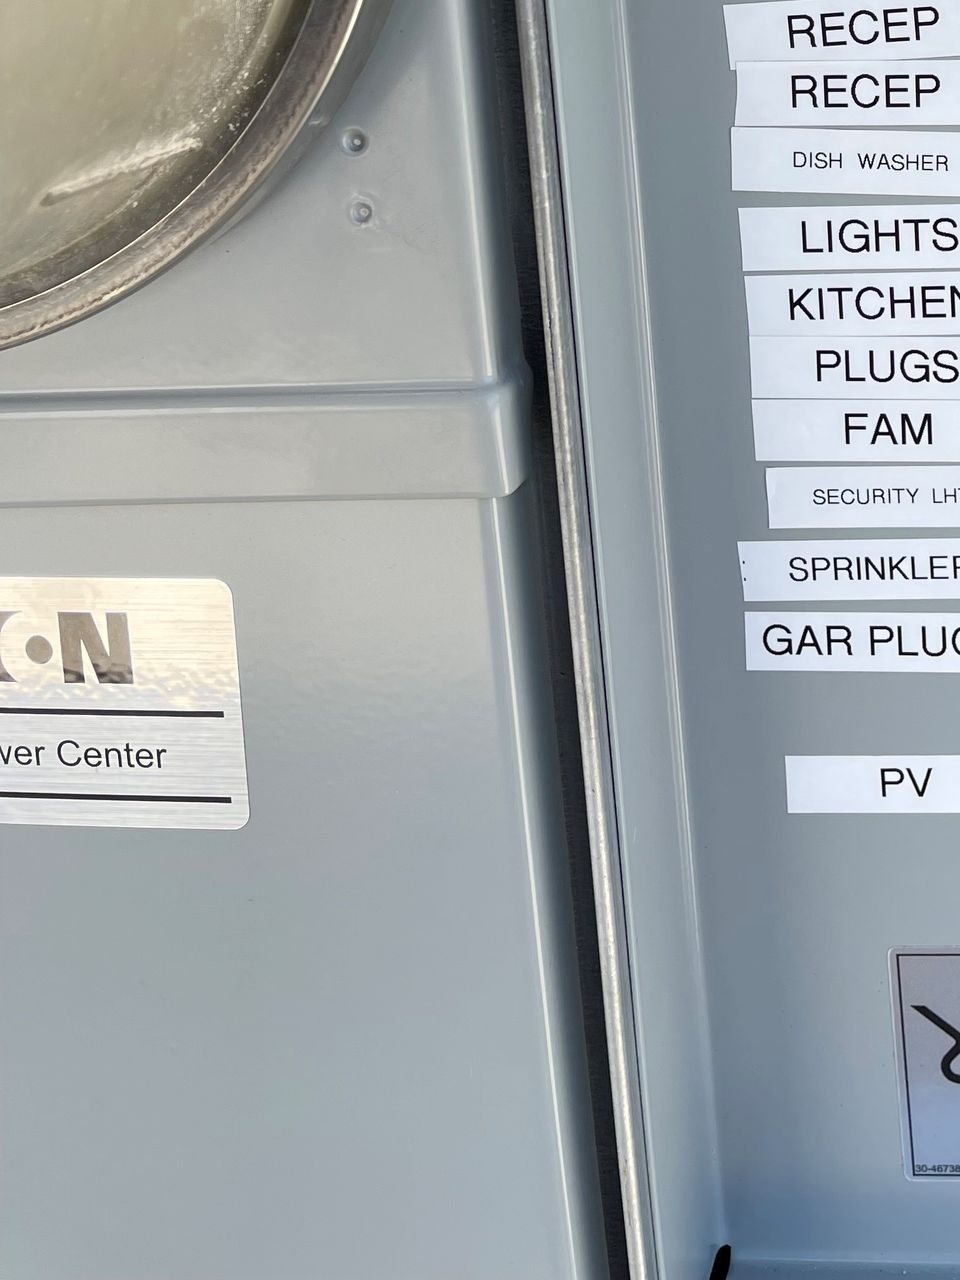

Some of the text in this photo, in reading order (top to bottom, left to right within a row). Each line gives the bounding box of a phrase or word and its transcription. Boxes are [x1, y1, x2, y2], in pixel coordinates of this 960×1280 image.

[787, 6, 940, 48] RECEP
[791, 73, 941, 109] RECEP
[793, 151, 950, 172] DISH WASHER
[801, 217, 959, 254] LIGHTS
[816, 349, 960, 384] PLUGS
[844, 413, 934, 445] FAM
[812, 488, 920, 505] SECURITY
[762, 624, 853, 656] GAR
[56, 739, 167, 769] Center
[879, 767, 933, 798] PV
